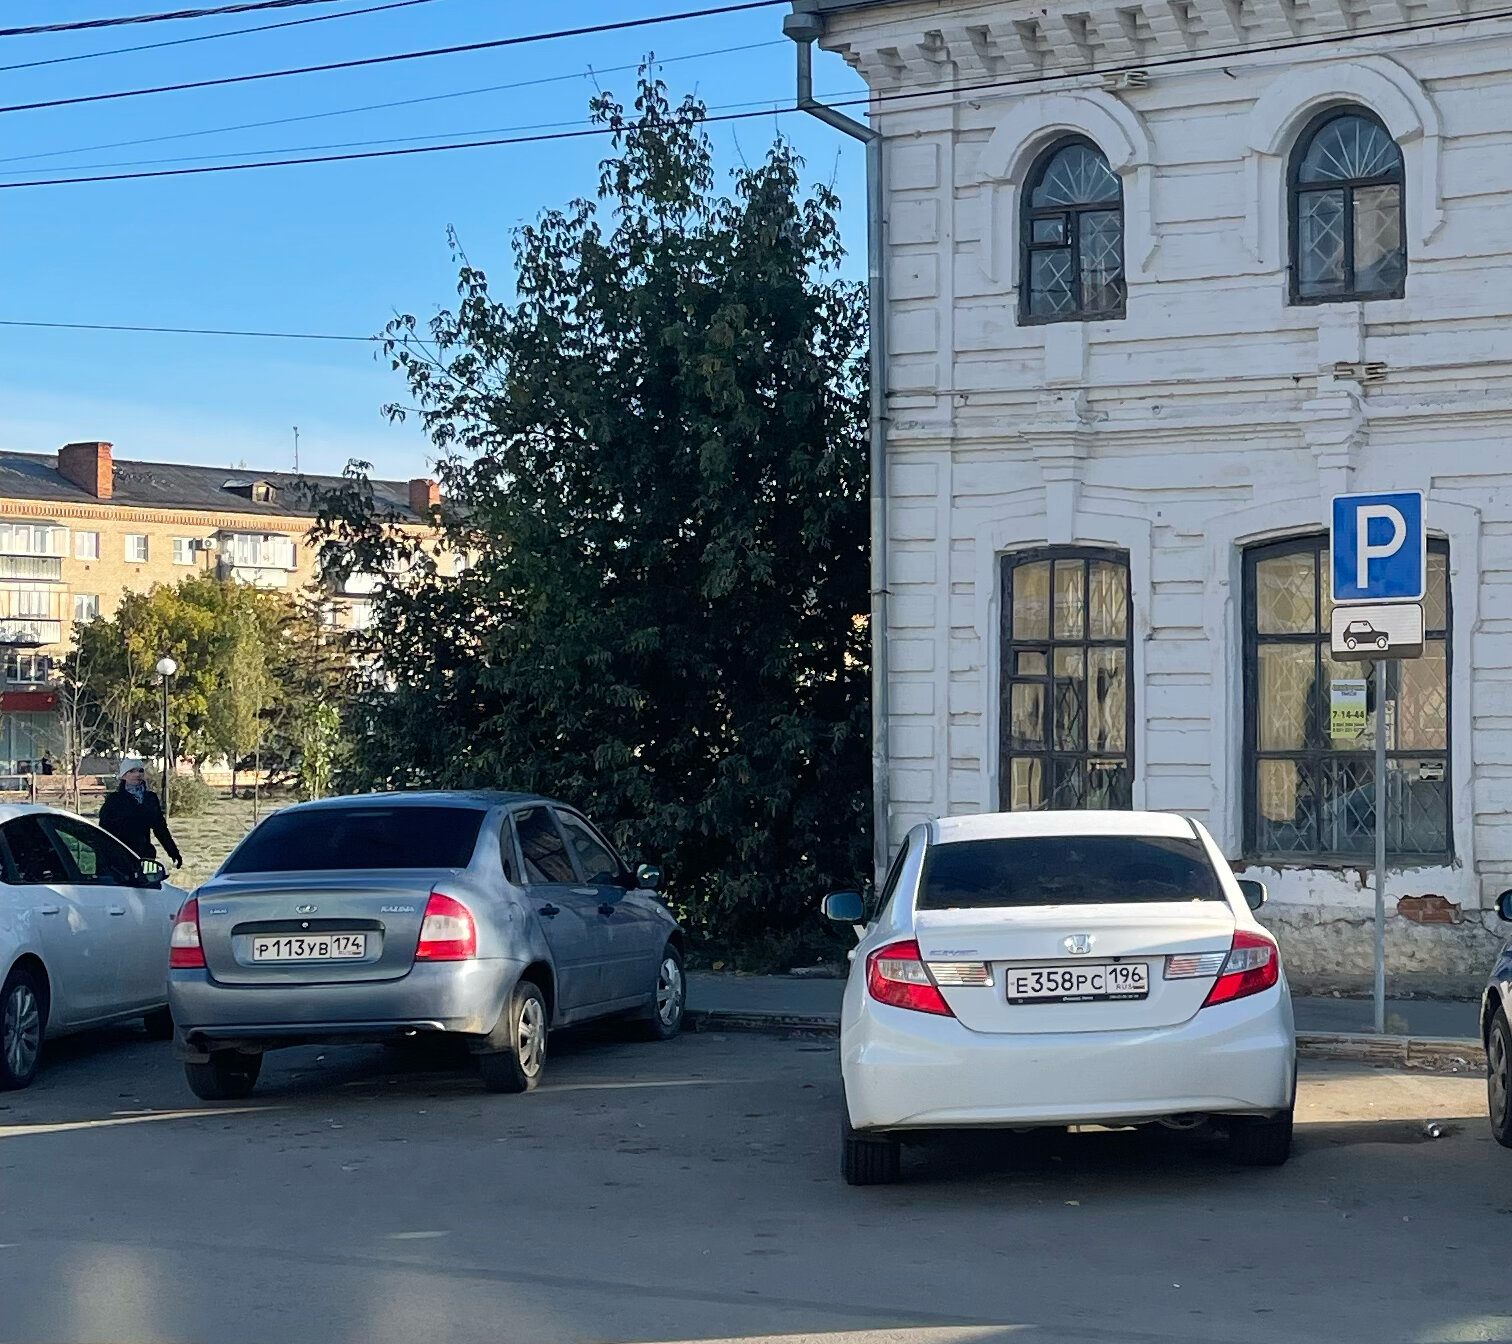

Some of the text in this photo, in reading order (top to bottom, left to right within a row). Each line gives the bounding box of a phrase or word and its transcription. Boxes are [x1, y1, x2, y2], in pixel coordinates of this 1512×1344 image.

[1357, 504, 1407, 589] P
[332, 936, 361, 951] 174
[1108, 966, 1143, 984] 196
